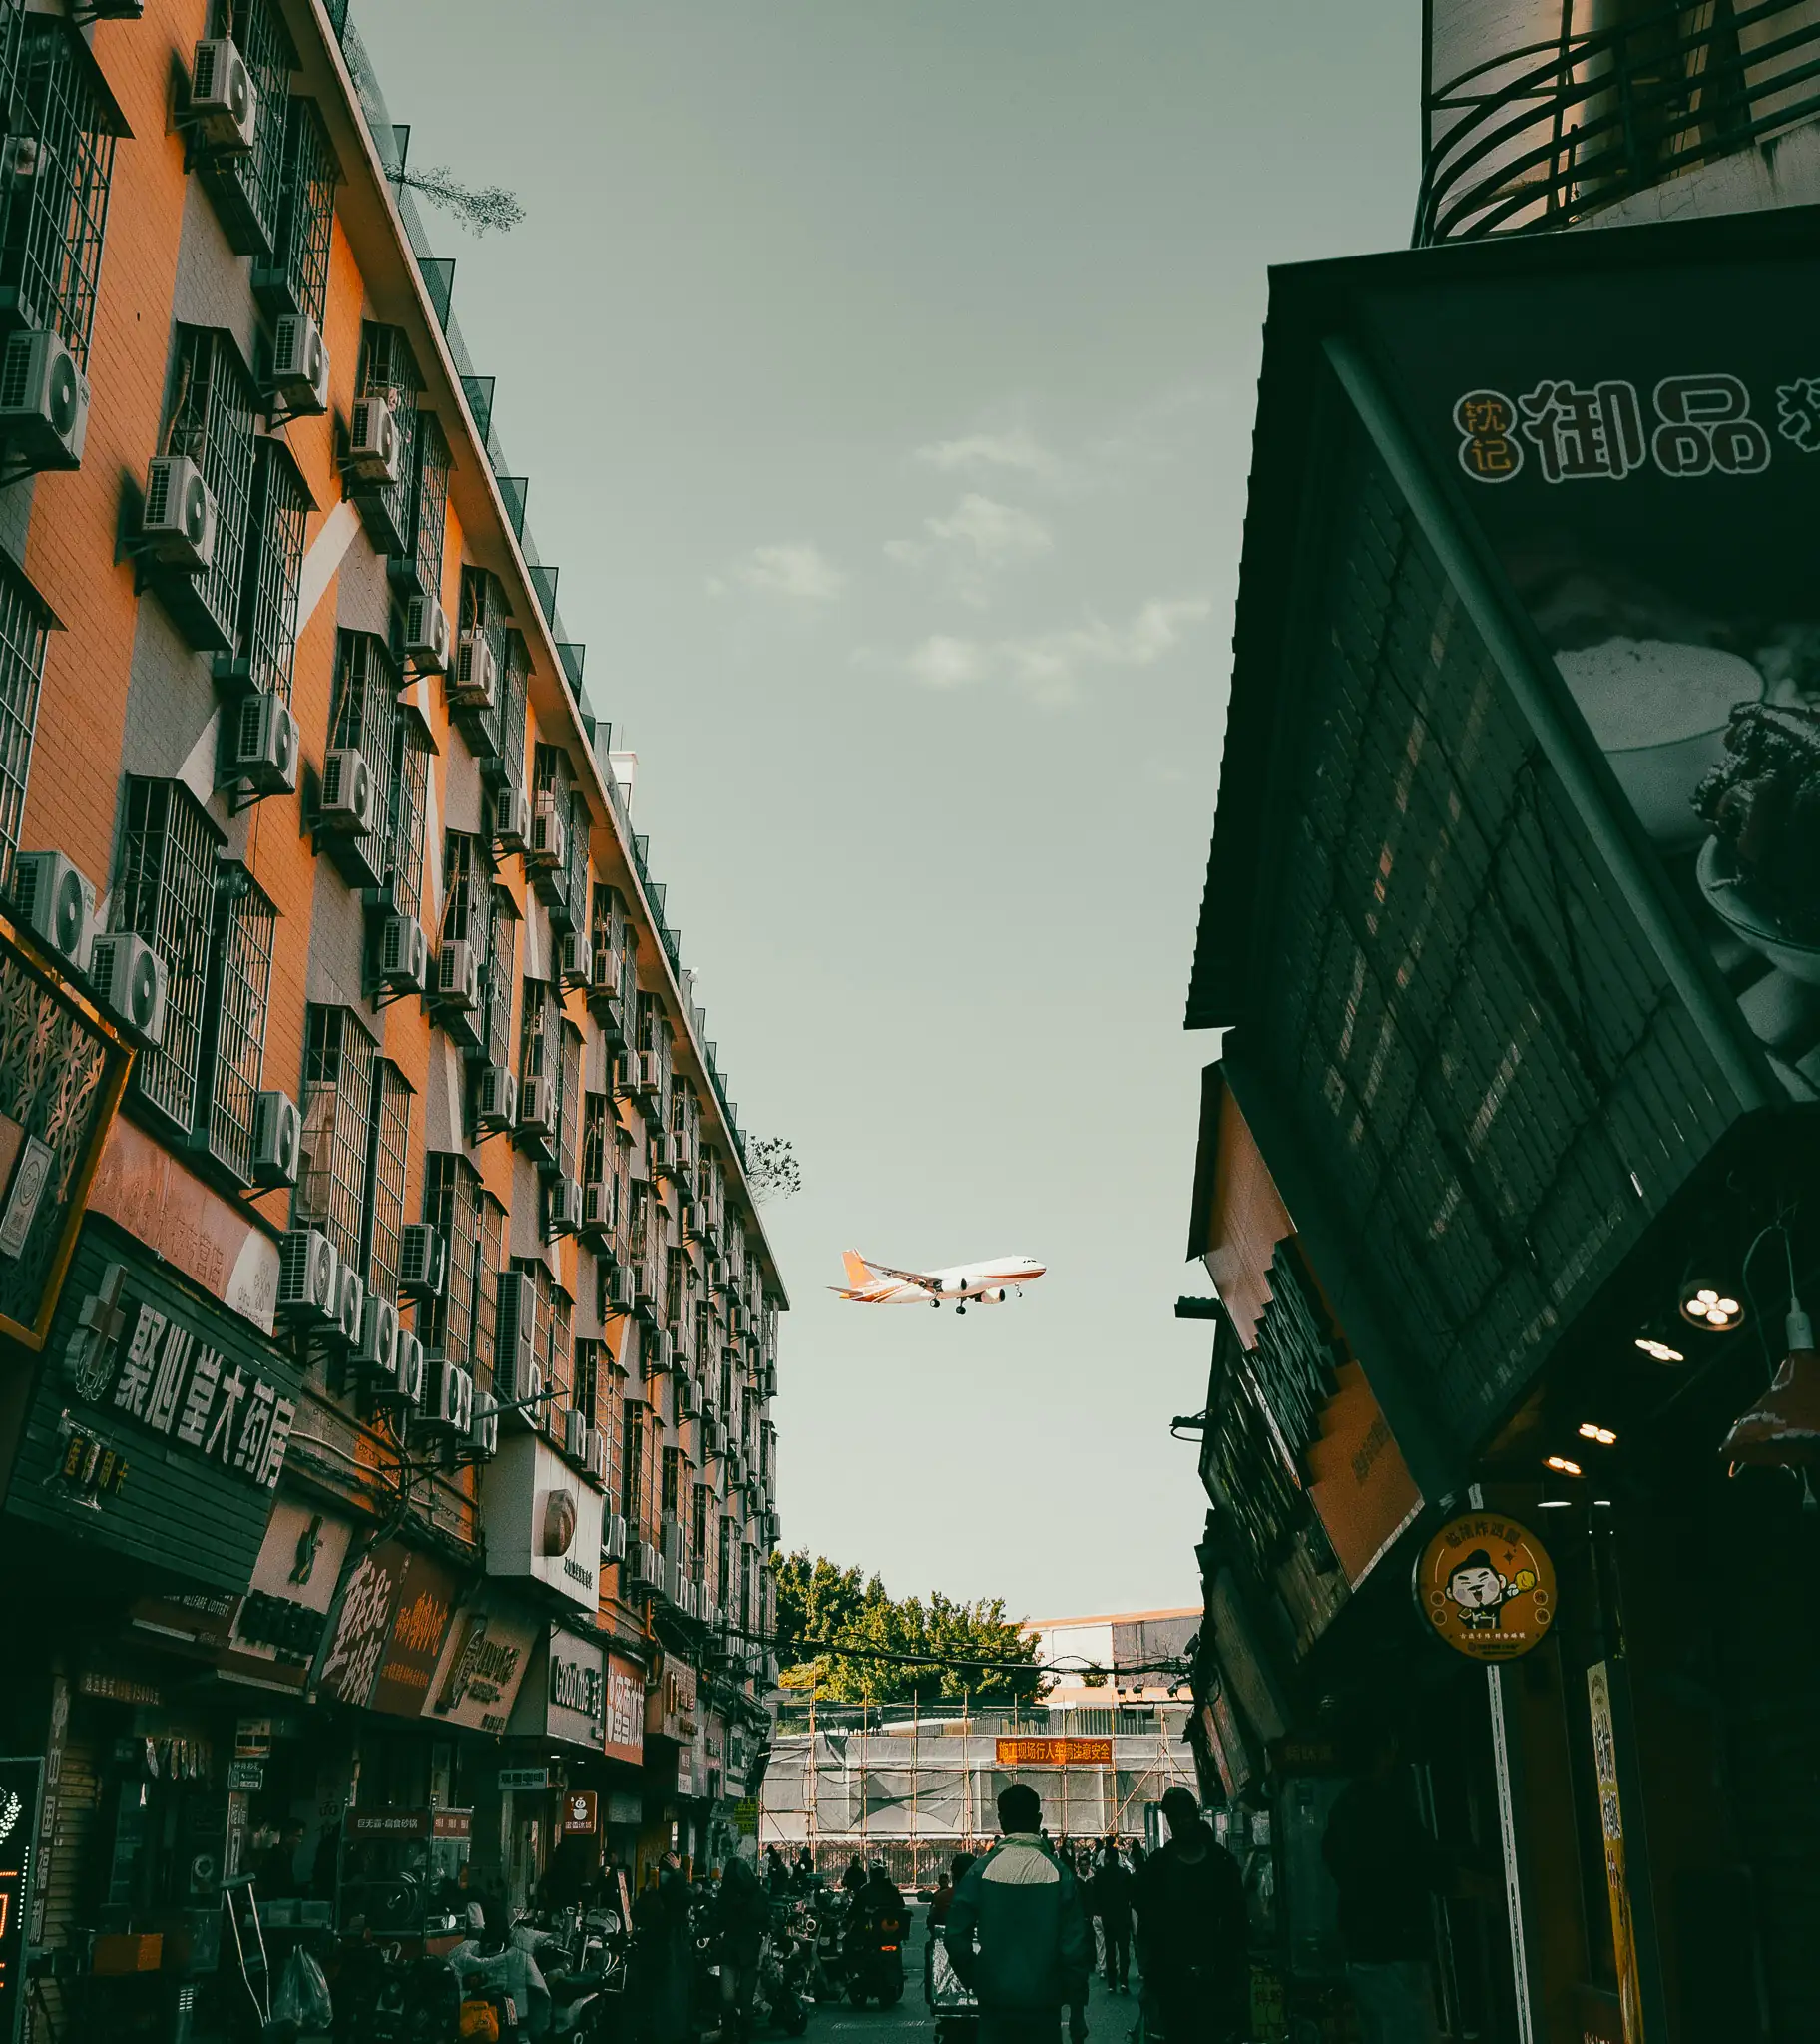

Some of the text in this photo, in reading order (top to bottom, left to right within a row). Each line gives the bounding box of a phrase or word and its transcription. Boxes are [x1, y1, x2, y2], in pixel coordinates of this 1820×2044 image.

[113, 1302, 295, 1489] 聚心堂大药房
[183, 1594, 208, 1609] WELFARE
[207, 1599, 230, 1617] LOTTERY
[999, 1741, 1110, 1760] 施工现场行人车辆注意安全
